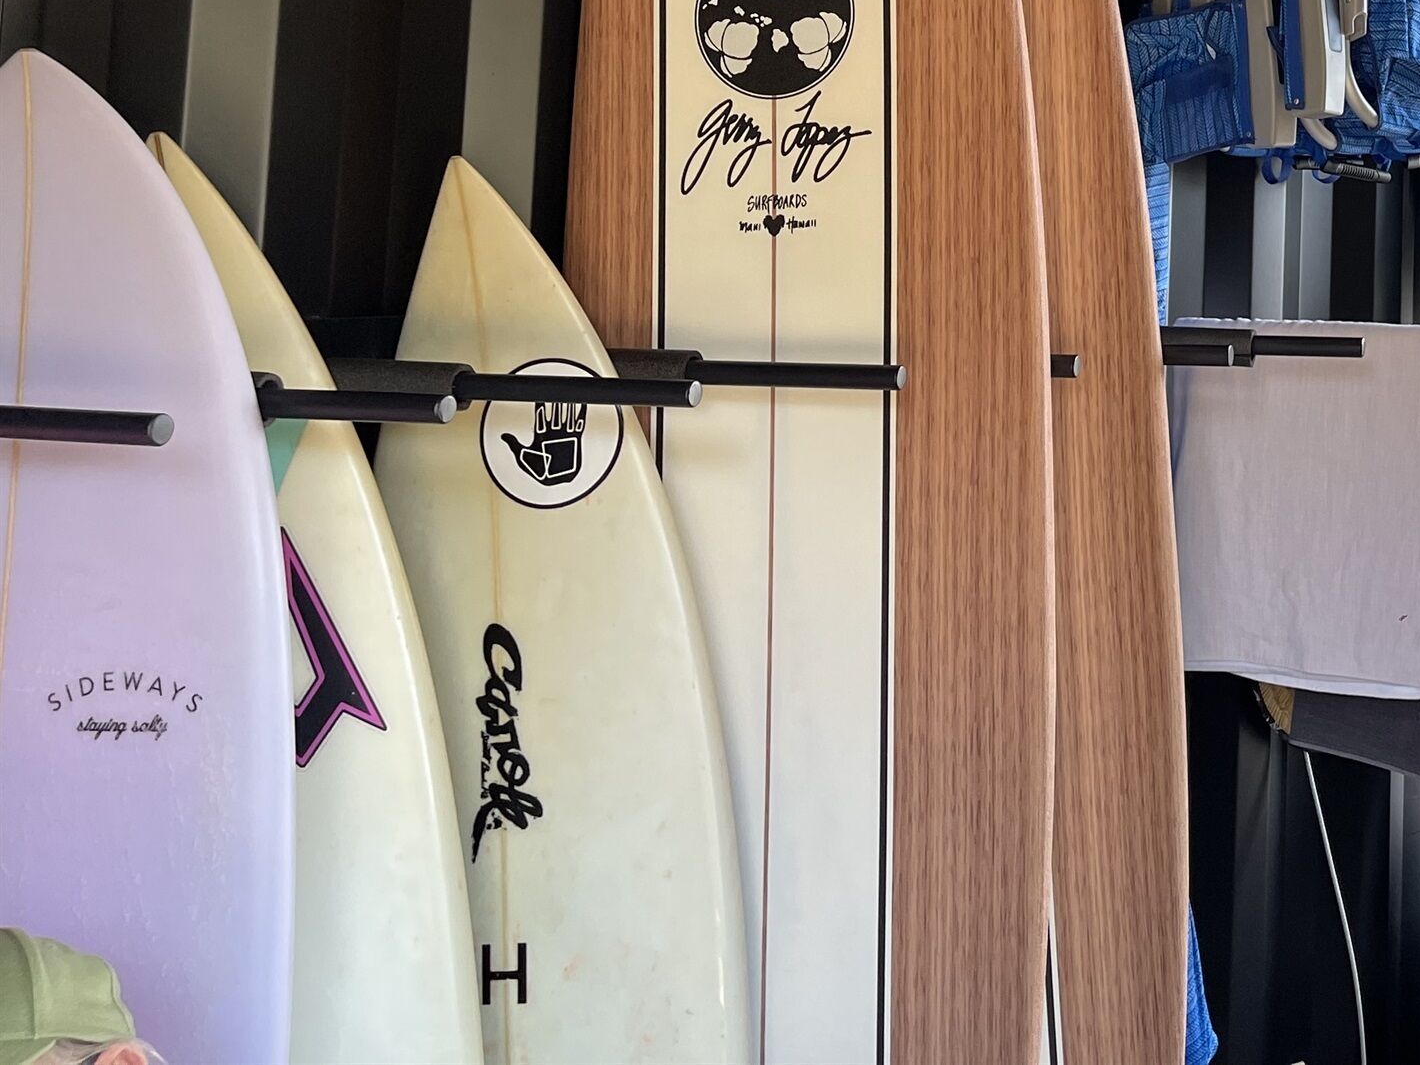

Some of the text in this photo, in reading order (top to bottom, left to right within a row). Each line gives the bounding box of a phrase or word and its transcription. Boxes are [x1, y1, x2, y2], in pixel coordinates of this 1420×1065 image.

[746, 193, 808, 215] SURFBOARDS
[47, 670, 204, 713] SIDEWAYS
[76, 713, 169, 741] staying salty
